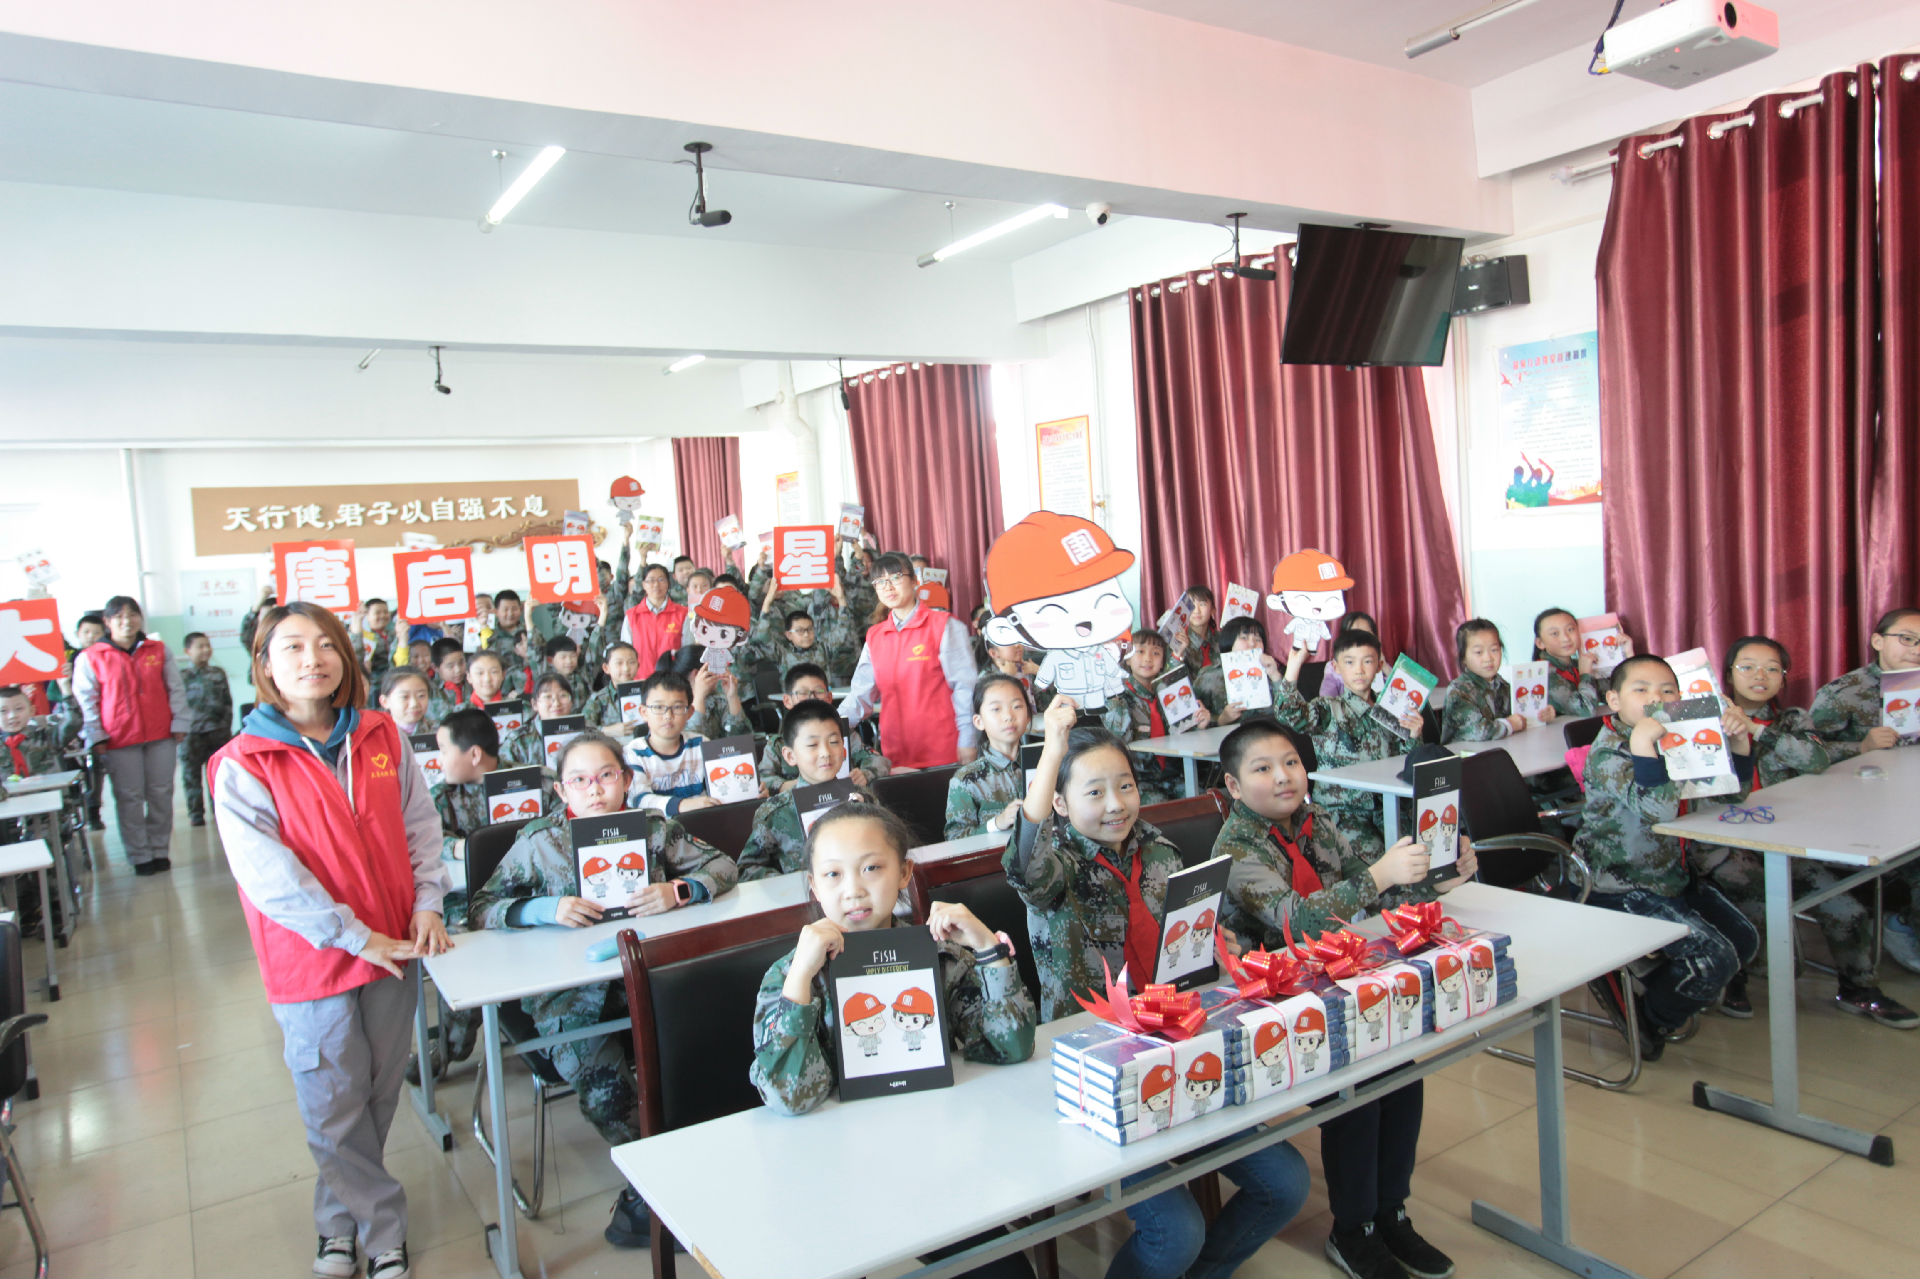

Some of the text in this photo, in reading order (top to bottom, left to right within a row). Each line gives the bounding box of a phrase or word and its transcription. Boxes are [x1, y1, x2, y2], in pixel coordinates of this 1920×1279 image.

[285, 547, 350, 607] 唐
[532, 540, 593, 596] 明
[779, 530, 830, 585] 星
[405, 554, 470, 618] 启
[602, 827, 619, 837] FISH
[873, 949, 897, 963] FISH
